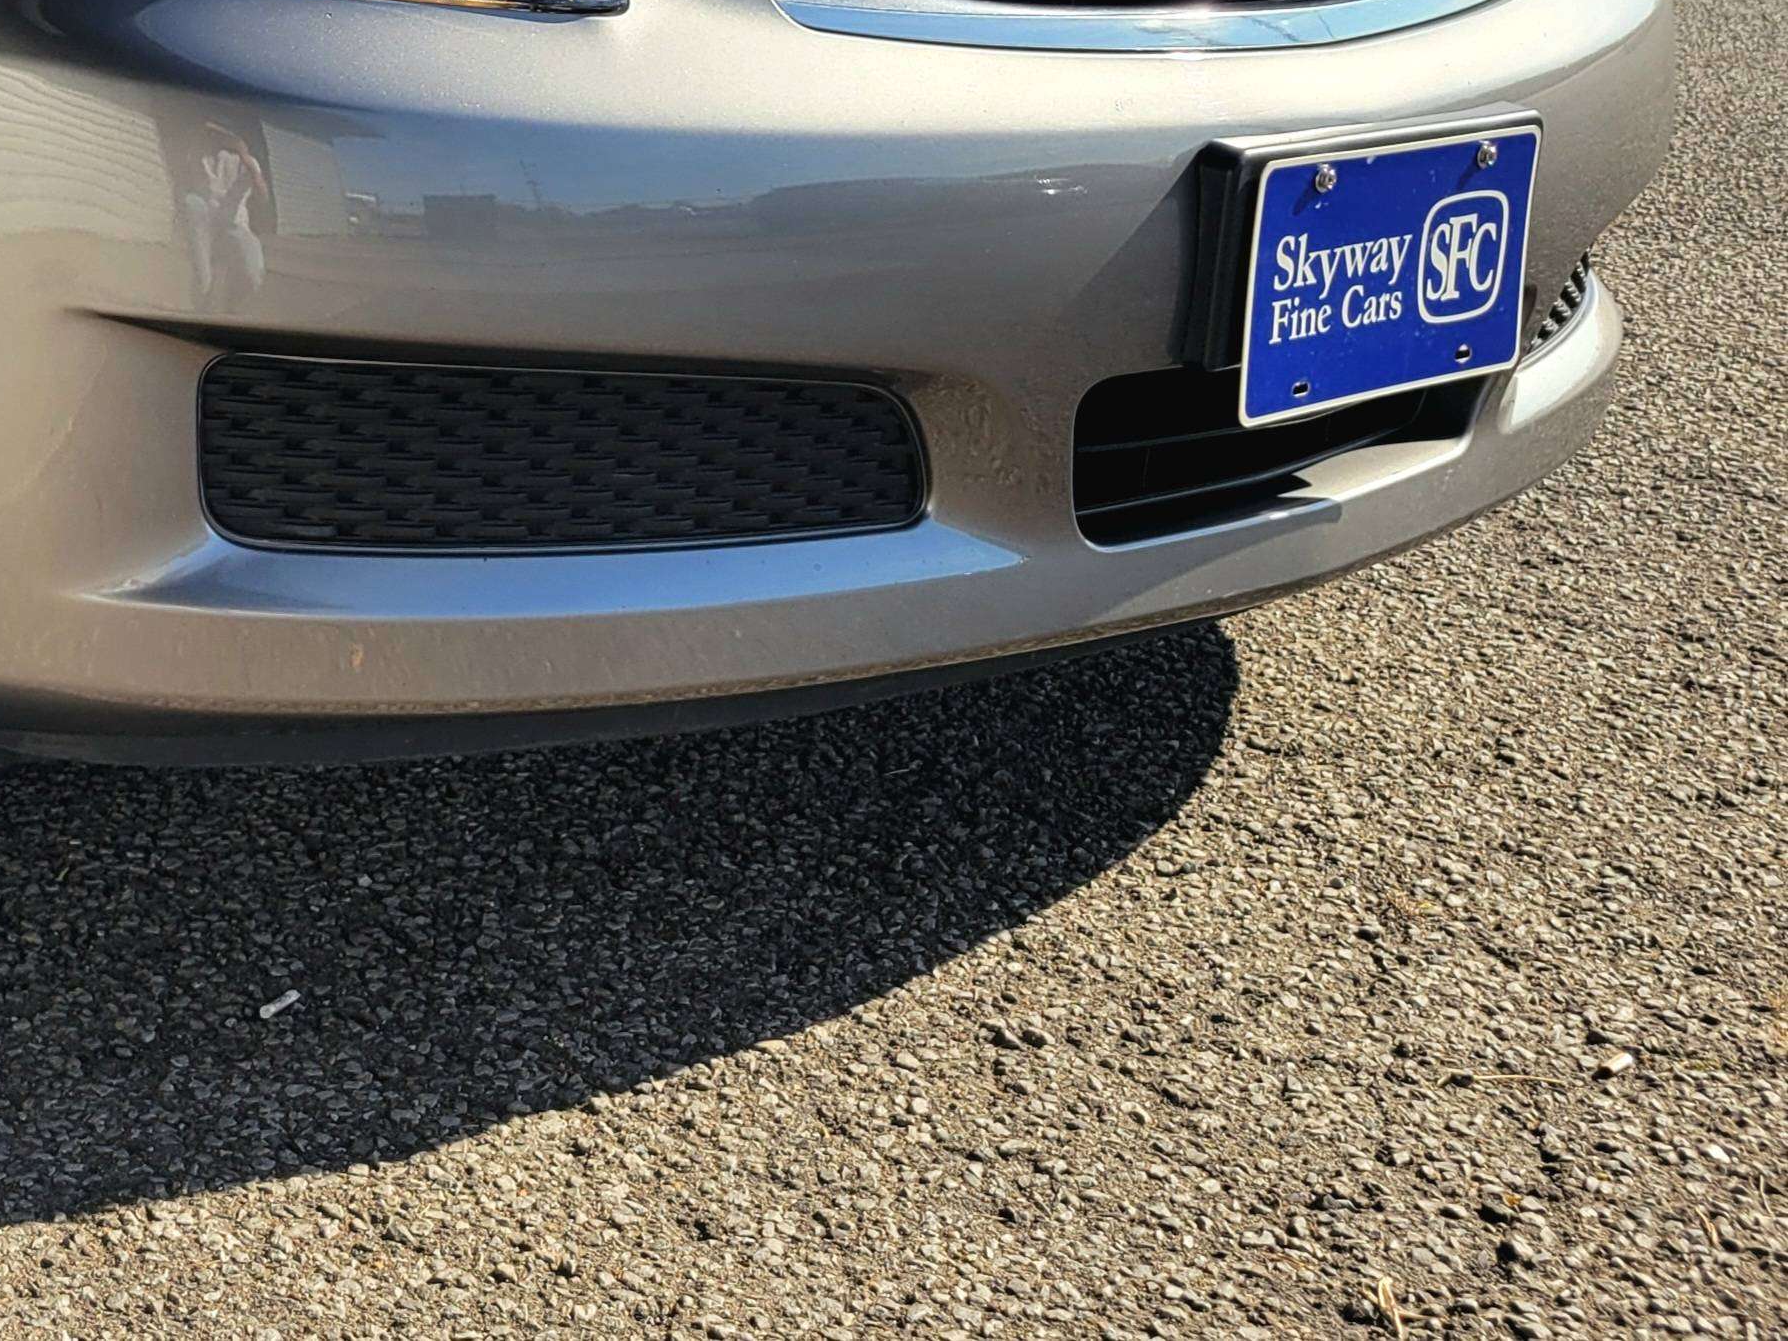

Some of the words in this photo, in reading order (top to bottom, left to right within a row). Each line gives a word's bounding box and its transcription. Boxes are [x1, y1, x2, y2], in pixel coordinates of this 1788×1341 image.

[1273, 233, 1413, 300] Skyway
[1426, 213, 1497, 302] SFC
[1269, 297, 1332, 345] Fine
[1342, 285, 1403, 328] Cars
